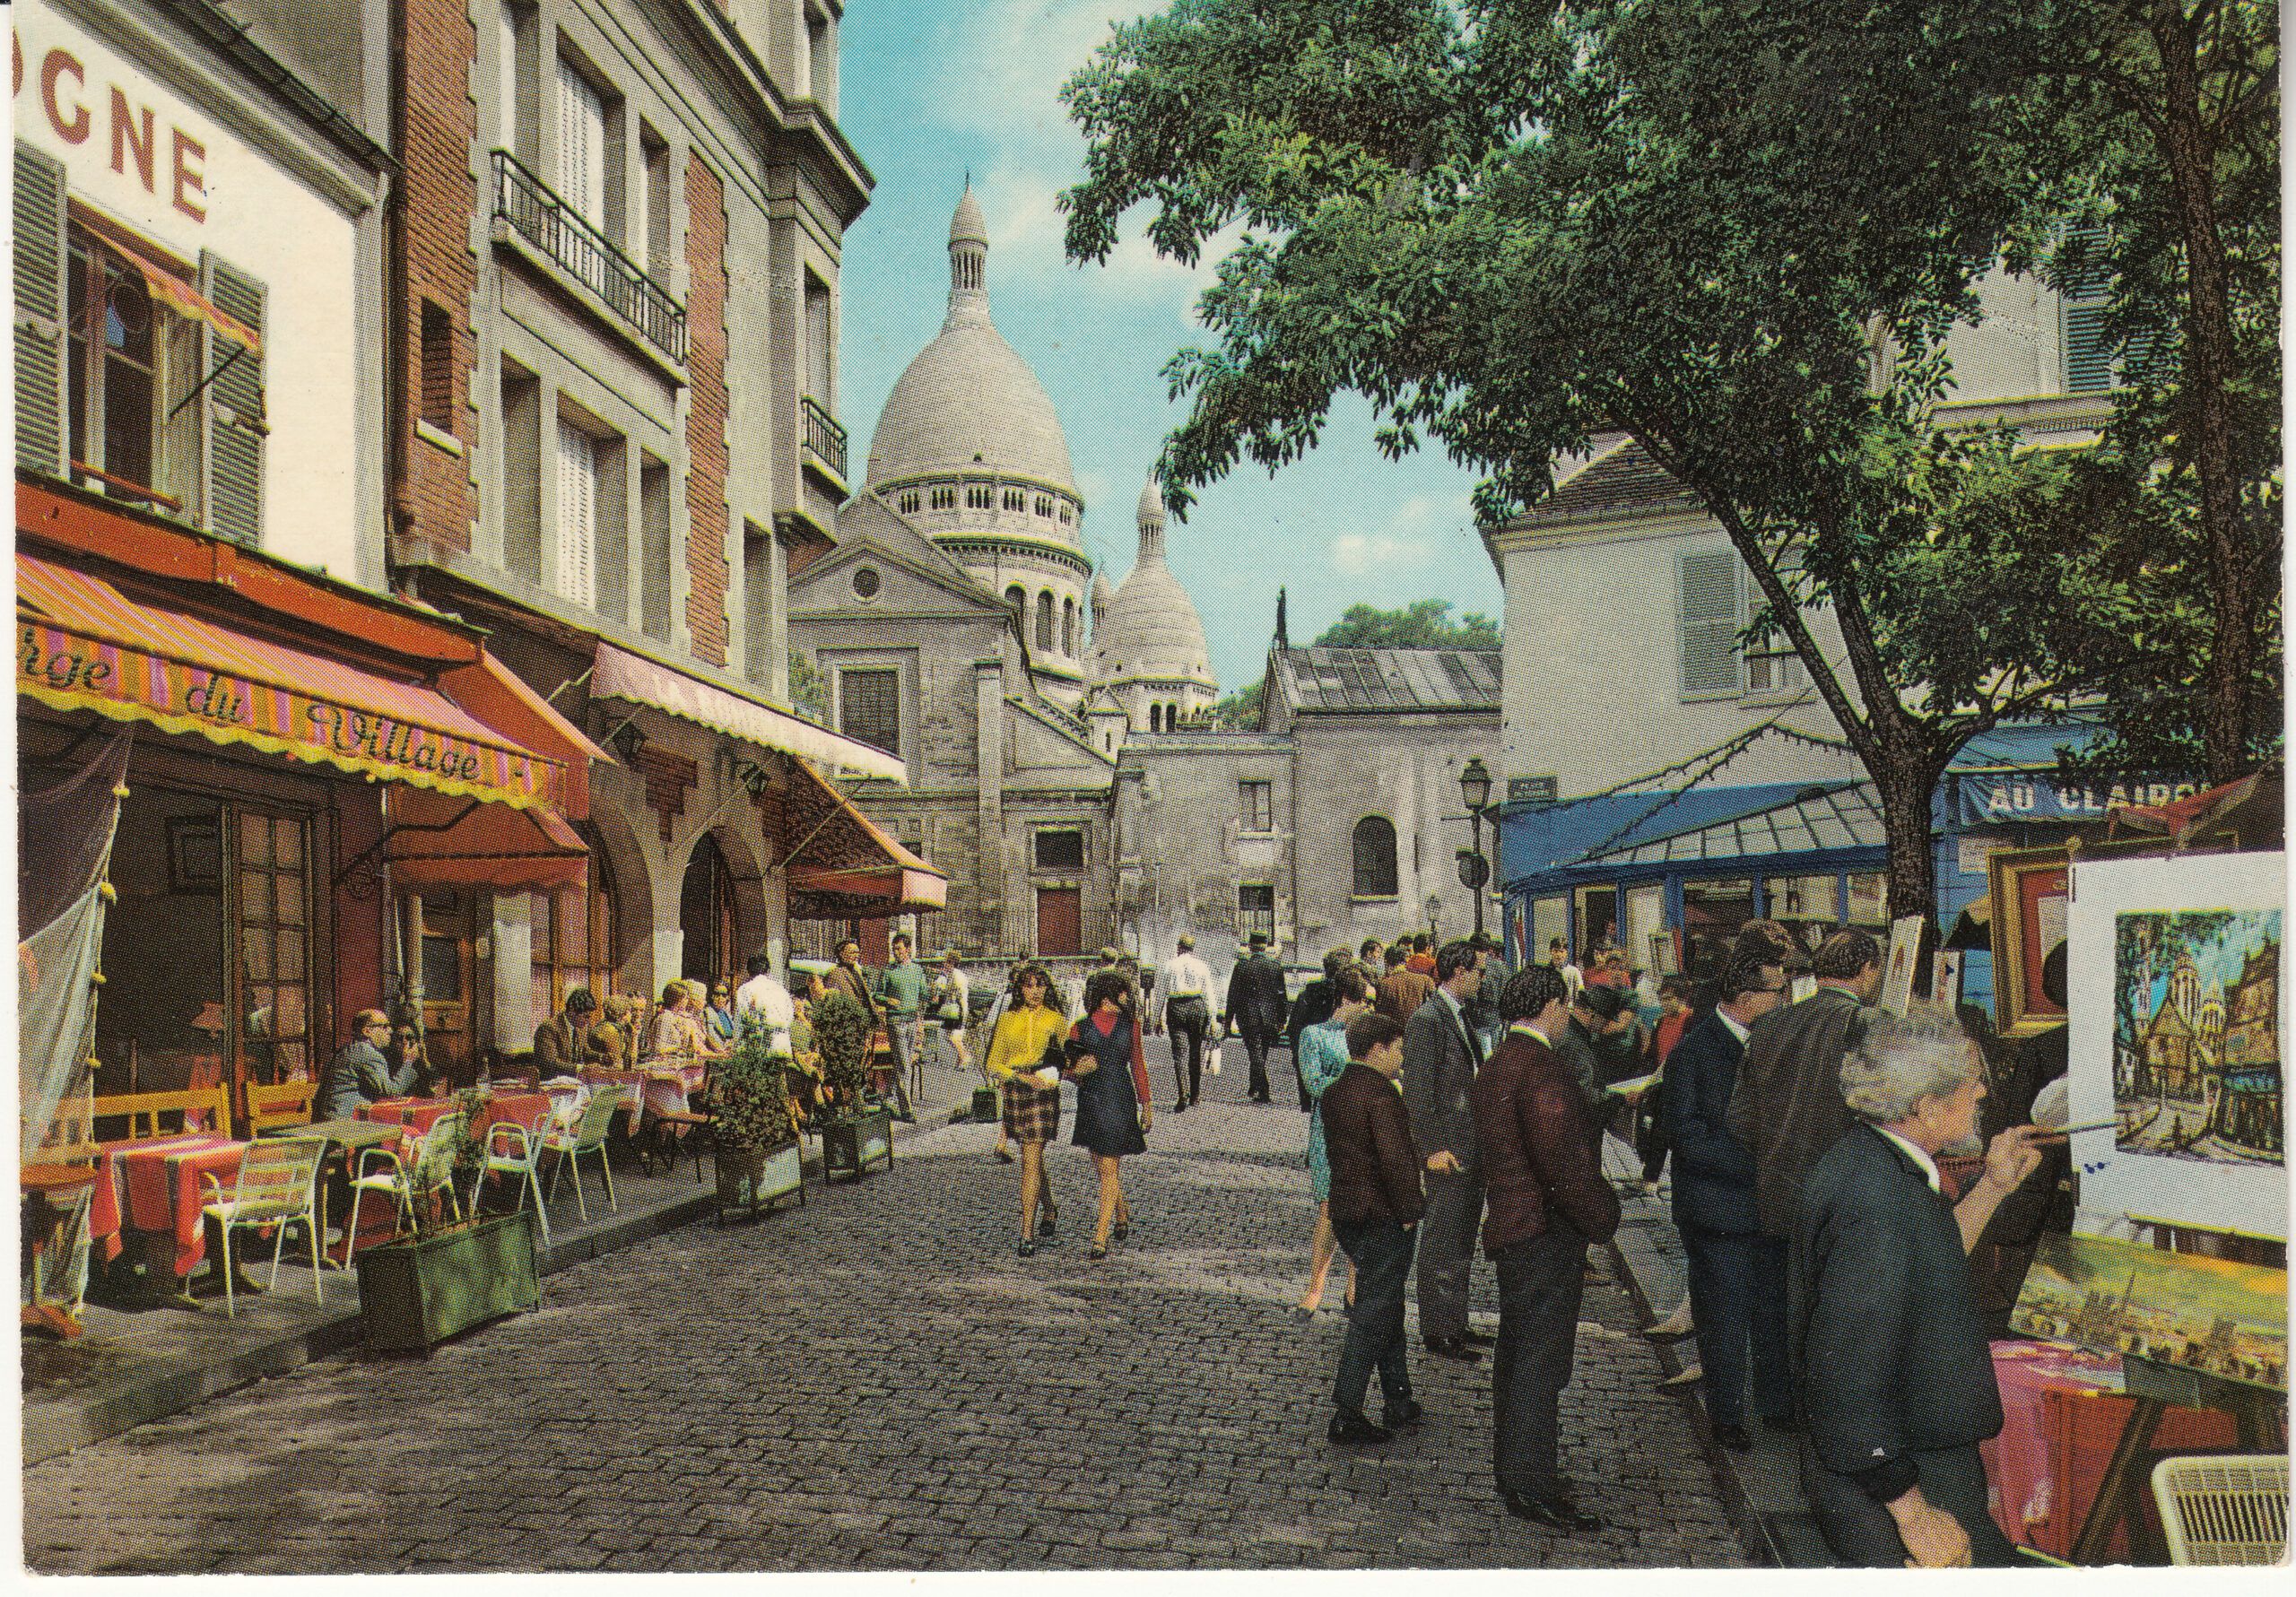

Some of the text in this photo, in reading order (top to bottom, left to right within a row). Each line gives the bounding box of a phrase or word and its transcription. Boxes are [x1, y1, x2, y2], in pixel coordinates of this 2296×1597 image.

[13, 27, 205, 224] GNE
[186, 673, 248, 725] du
[308, 705, 479, 779] Village
[1989, 785, 2035, 812] AU
